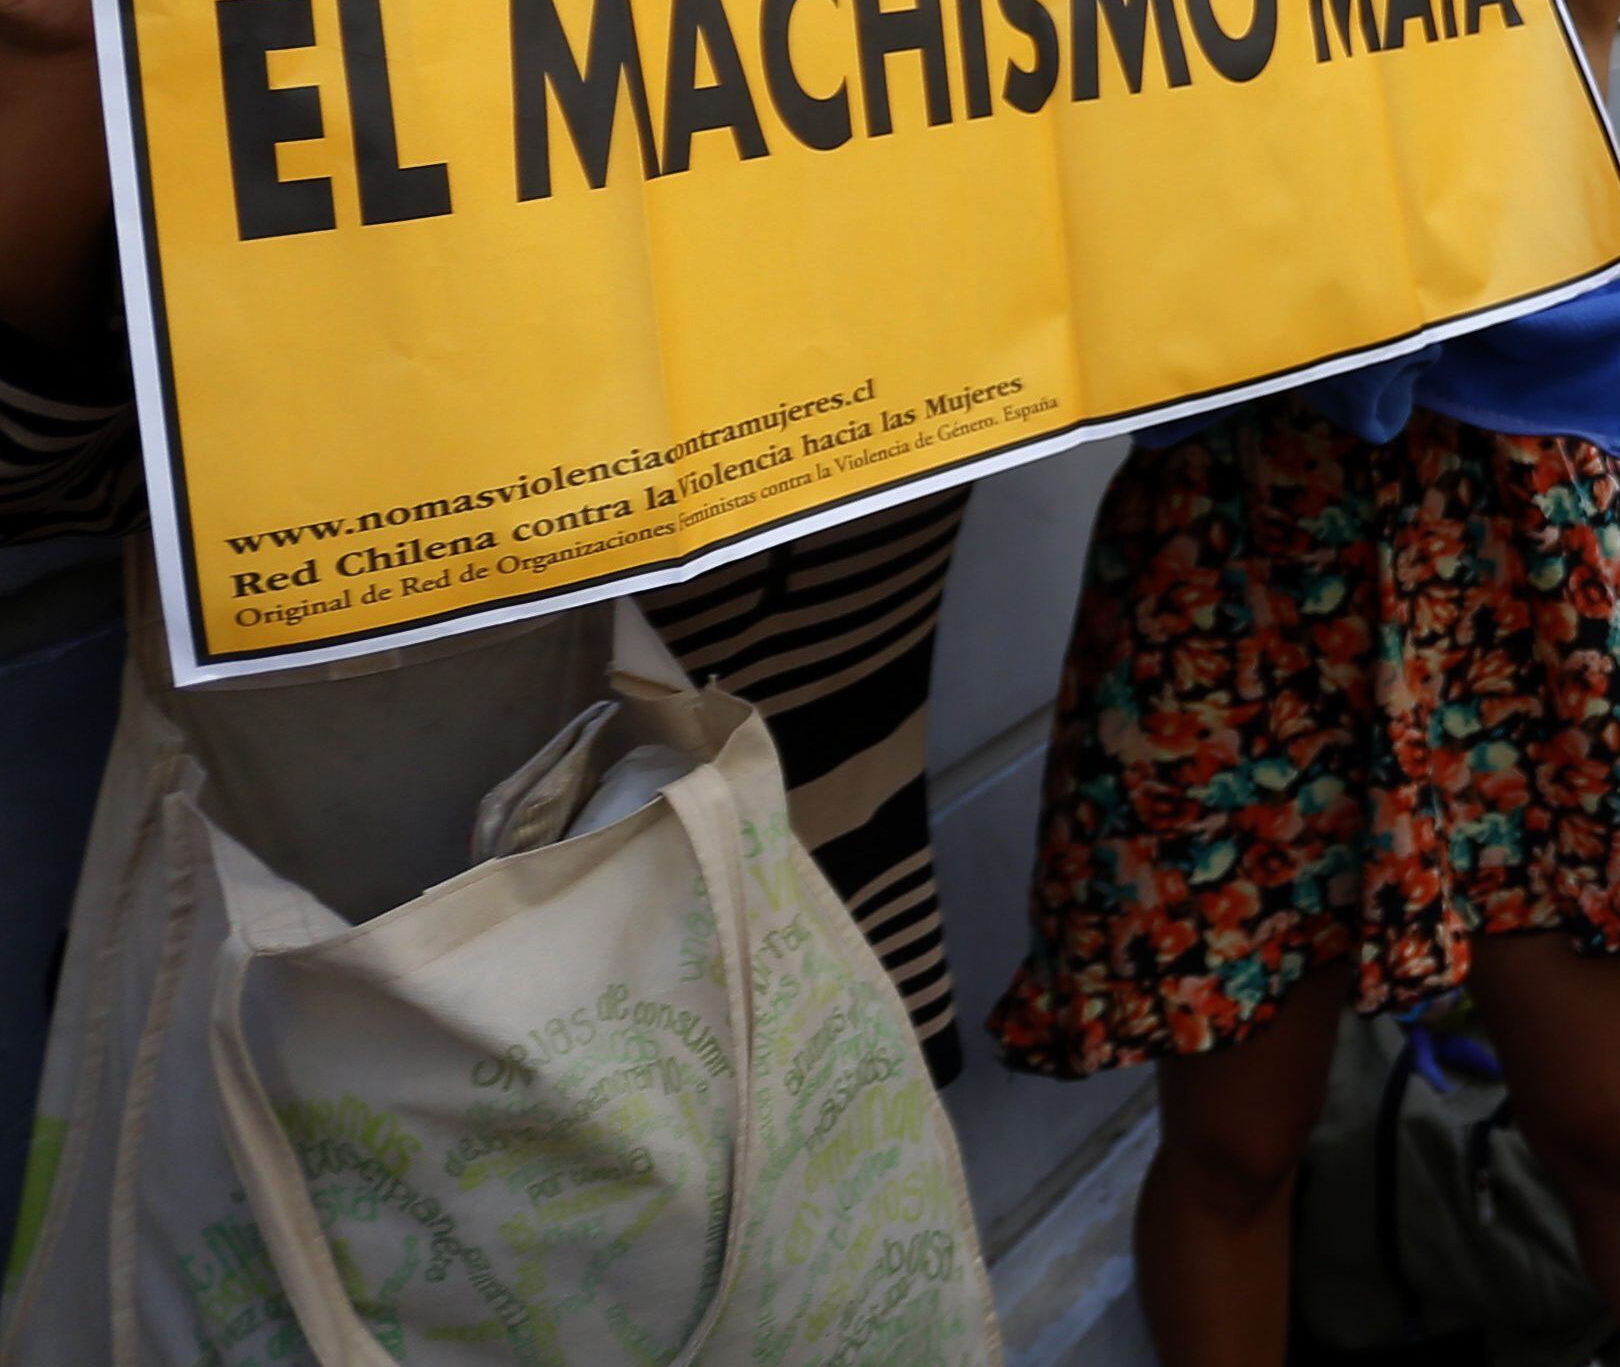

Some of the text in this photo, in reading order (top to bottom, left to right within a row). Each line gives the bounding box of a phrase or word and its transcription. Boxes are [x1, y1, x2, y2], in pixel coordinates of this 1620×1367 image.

[223, 377, 877, 555] www.nomasviolenciacontramujeres.cl
[229, 375, 1024, 599] Red Chilena contra la Violencia hacia las Mujeres
[235, 396, 1059, 628] Original de Red de Organizaciones Feministas contra la Violencia de Género. España
